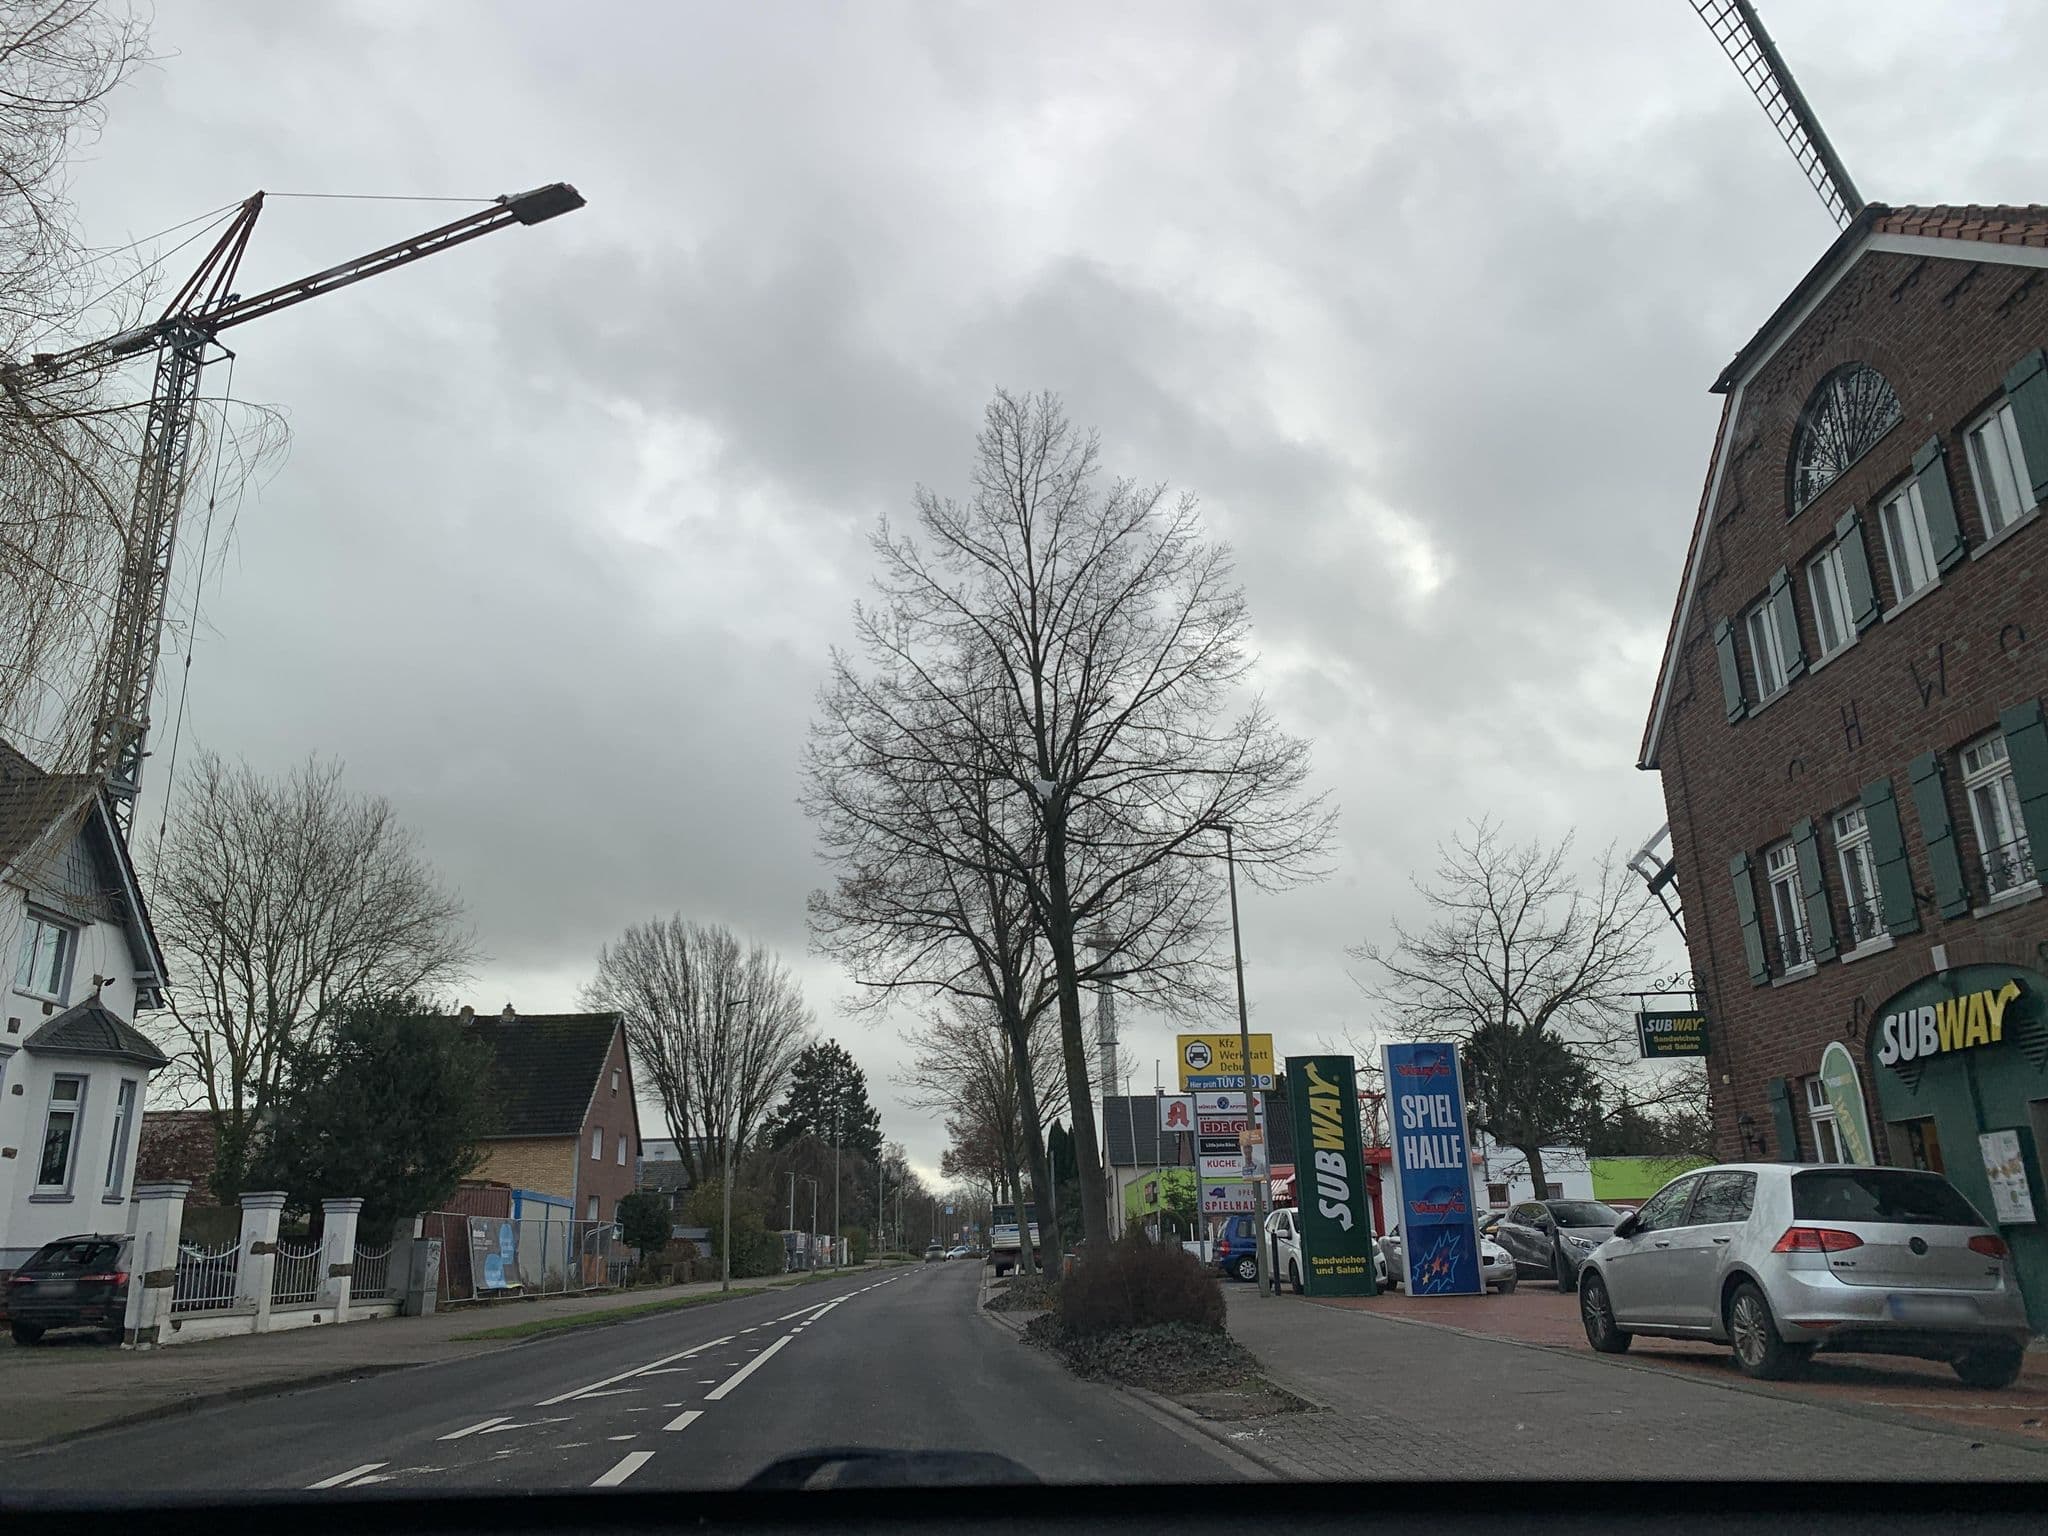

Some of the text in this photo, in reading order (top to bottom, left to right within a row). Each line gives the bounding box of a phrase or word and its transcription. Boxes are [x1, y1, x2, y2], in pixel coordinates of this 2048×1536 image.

[1645, 1017, 1705, 1032] SUBWAY
[1877, 977, 2021, 1067] SUBWAY
[1219, 1038, 1235, 1048] Kfz
[1220, 1051, 1268, 1060] Werktatt
[1220, 1062, 1245, 1071] Debu
[1190, 1080, 1202, 1088] Hier
[1216, 1075, 1235, 1088] TÜV
[1400, 1094, 1457, 1129] SPIEL
[1304, 1061, 1354, 1232] SUBWAY
[1403, 1135, 1463, 1170] HALLE
[1205, 1200, 1268, 1211] SPIELHALE
[1311, 1256, 1367, 1265] Sandwiches
[1316, 1265, 1365, 1275] und Salate
